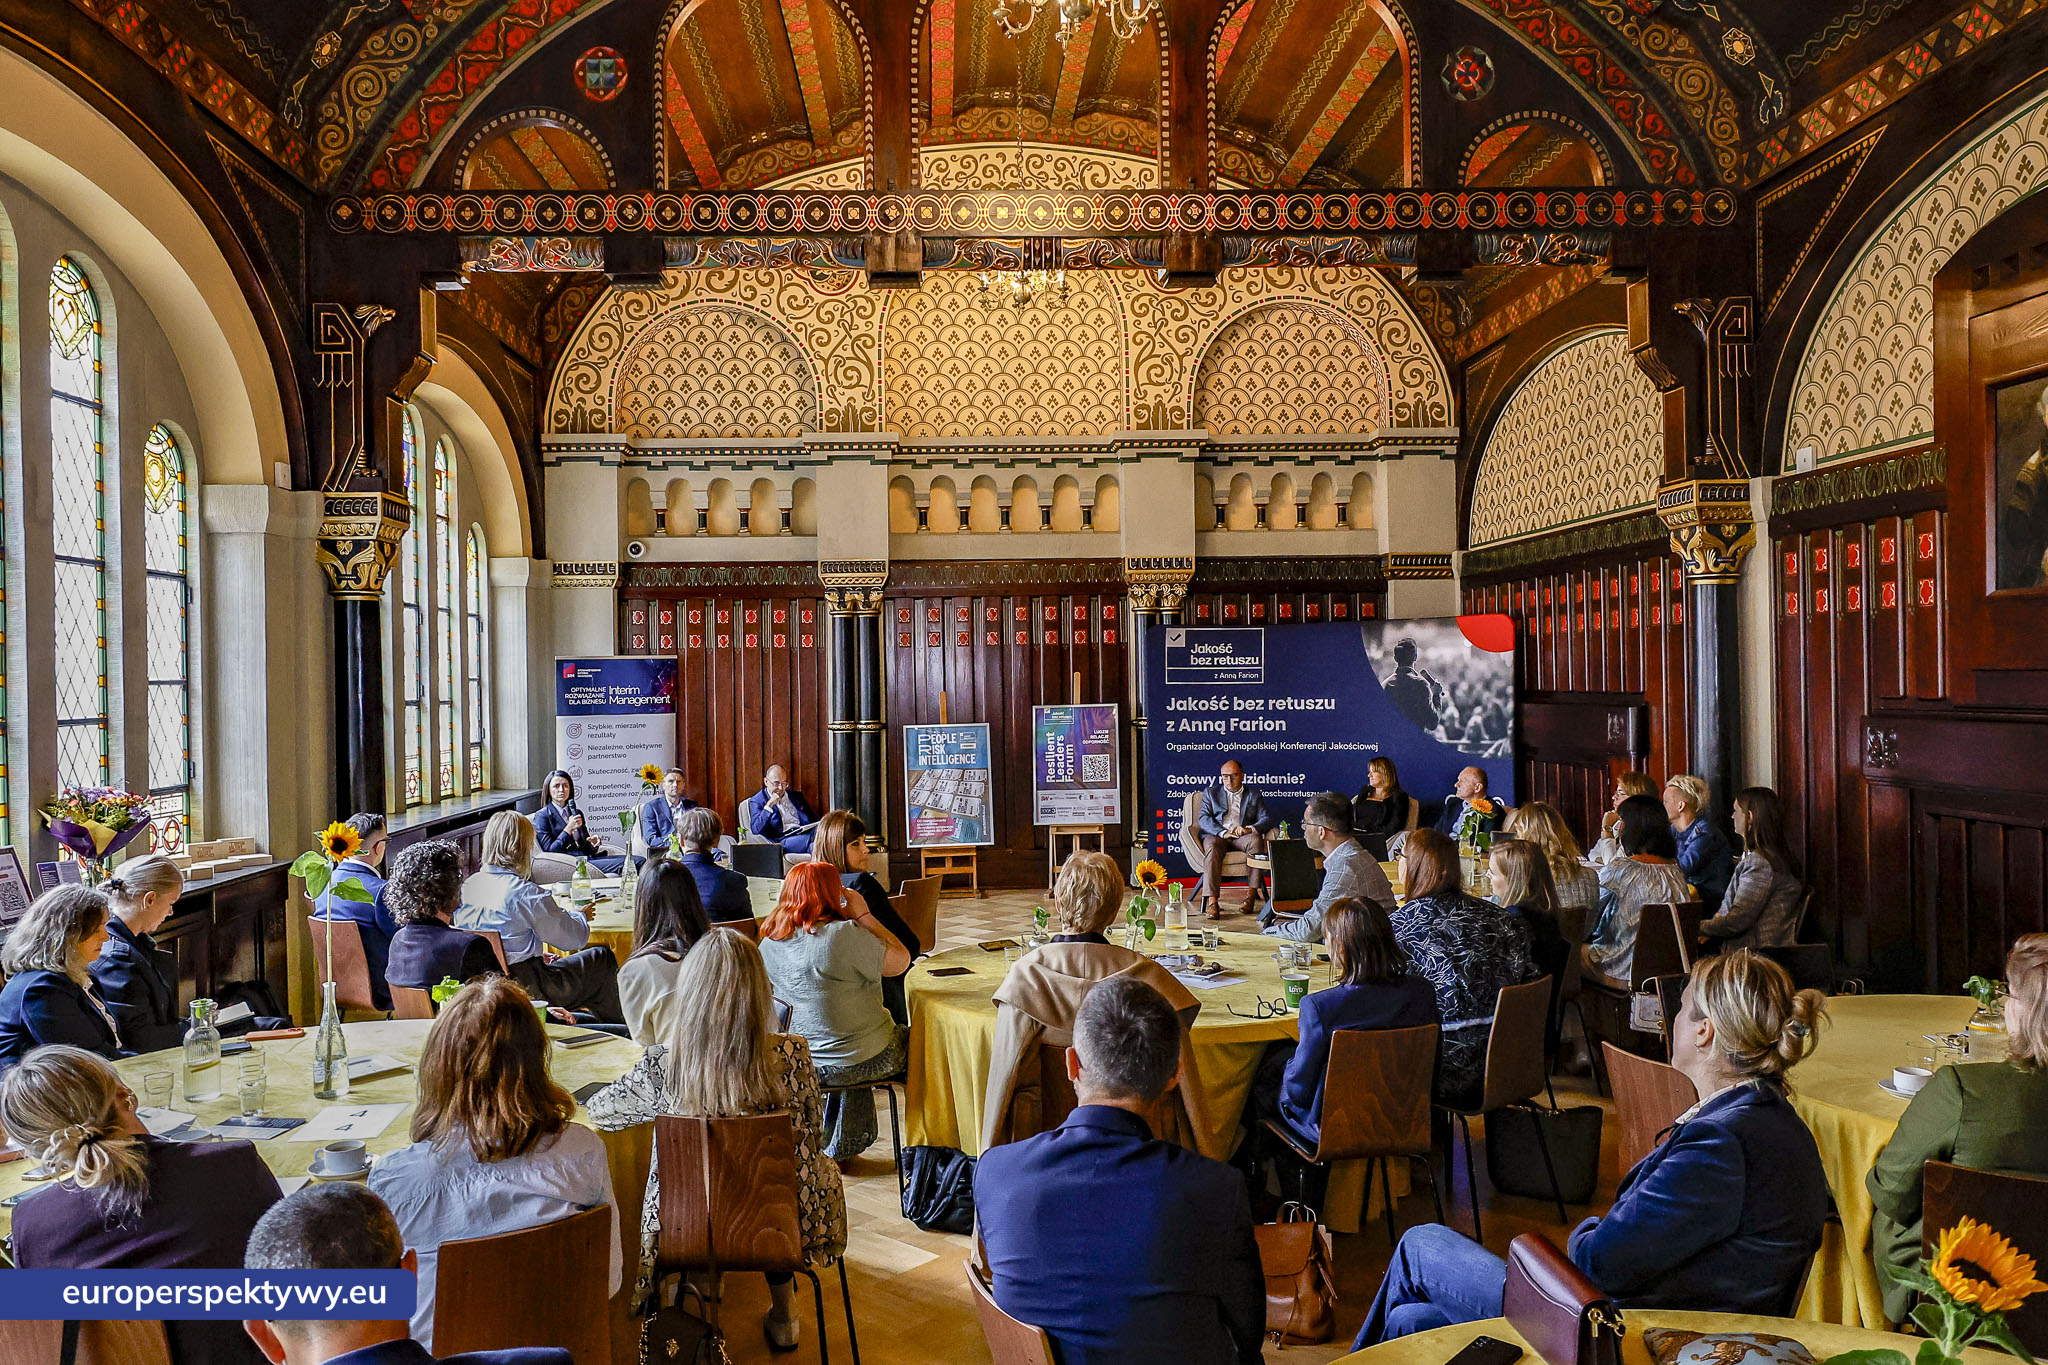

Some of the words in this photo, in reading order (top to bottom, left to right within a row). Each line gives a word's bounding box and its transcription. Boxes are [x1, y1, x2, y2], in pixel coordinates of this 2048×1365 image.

[1190, 643, 1233, 654] Jakość
[1190, 654, 1212, 665] bez
[1213, 655, 1259, 665] retuszu
[1219, 672, 1237, 680] Anną
[1238, 671, 1259, 679] Farion
[609, 684, 641, 695] Interim
[564, 692, 605, 700] ROZWIĄZANIE
[609, 694, 671, 706] Management
[1166, 695, 1230, 711] Jakość
[1233, 696, 1265, 711] bez
[1268, 698, 1336, 711] retuszu
[587, 723, 614, 731] Szybkie,
[1166, 720, 1175, 732] z
[1178, 717, 1226, 735] Anną
[1229, 716, 1287, 732] Farion
[587, 731, 617, 739] rezultaty
[918, 732, 957, 745] PEOPLE
[625, 742, 663, 750] obiektywne
[918, 744, 946, 755] RISK
[1166, 741, 1215, 753] Organizator
[1216, 741, 1279, 752] Ogólnopolskiej
[1279, 741, 1327, 751] Konferencji
[1328, 741, 1379, 752] Jakościowej
[587, 752, 627, 760] partnerstwo
[918, 753, 977, 766] INTELLIGENCE
[1045, 731, 1056, 783] Resilient
[1055, 735, 1065, 783] Leaders
[1065, 744, 1075, 783] Forum
[1166, 774, 1216, 788] Gotowy
[588, 791, 627, 800] sprawdzone
